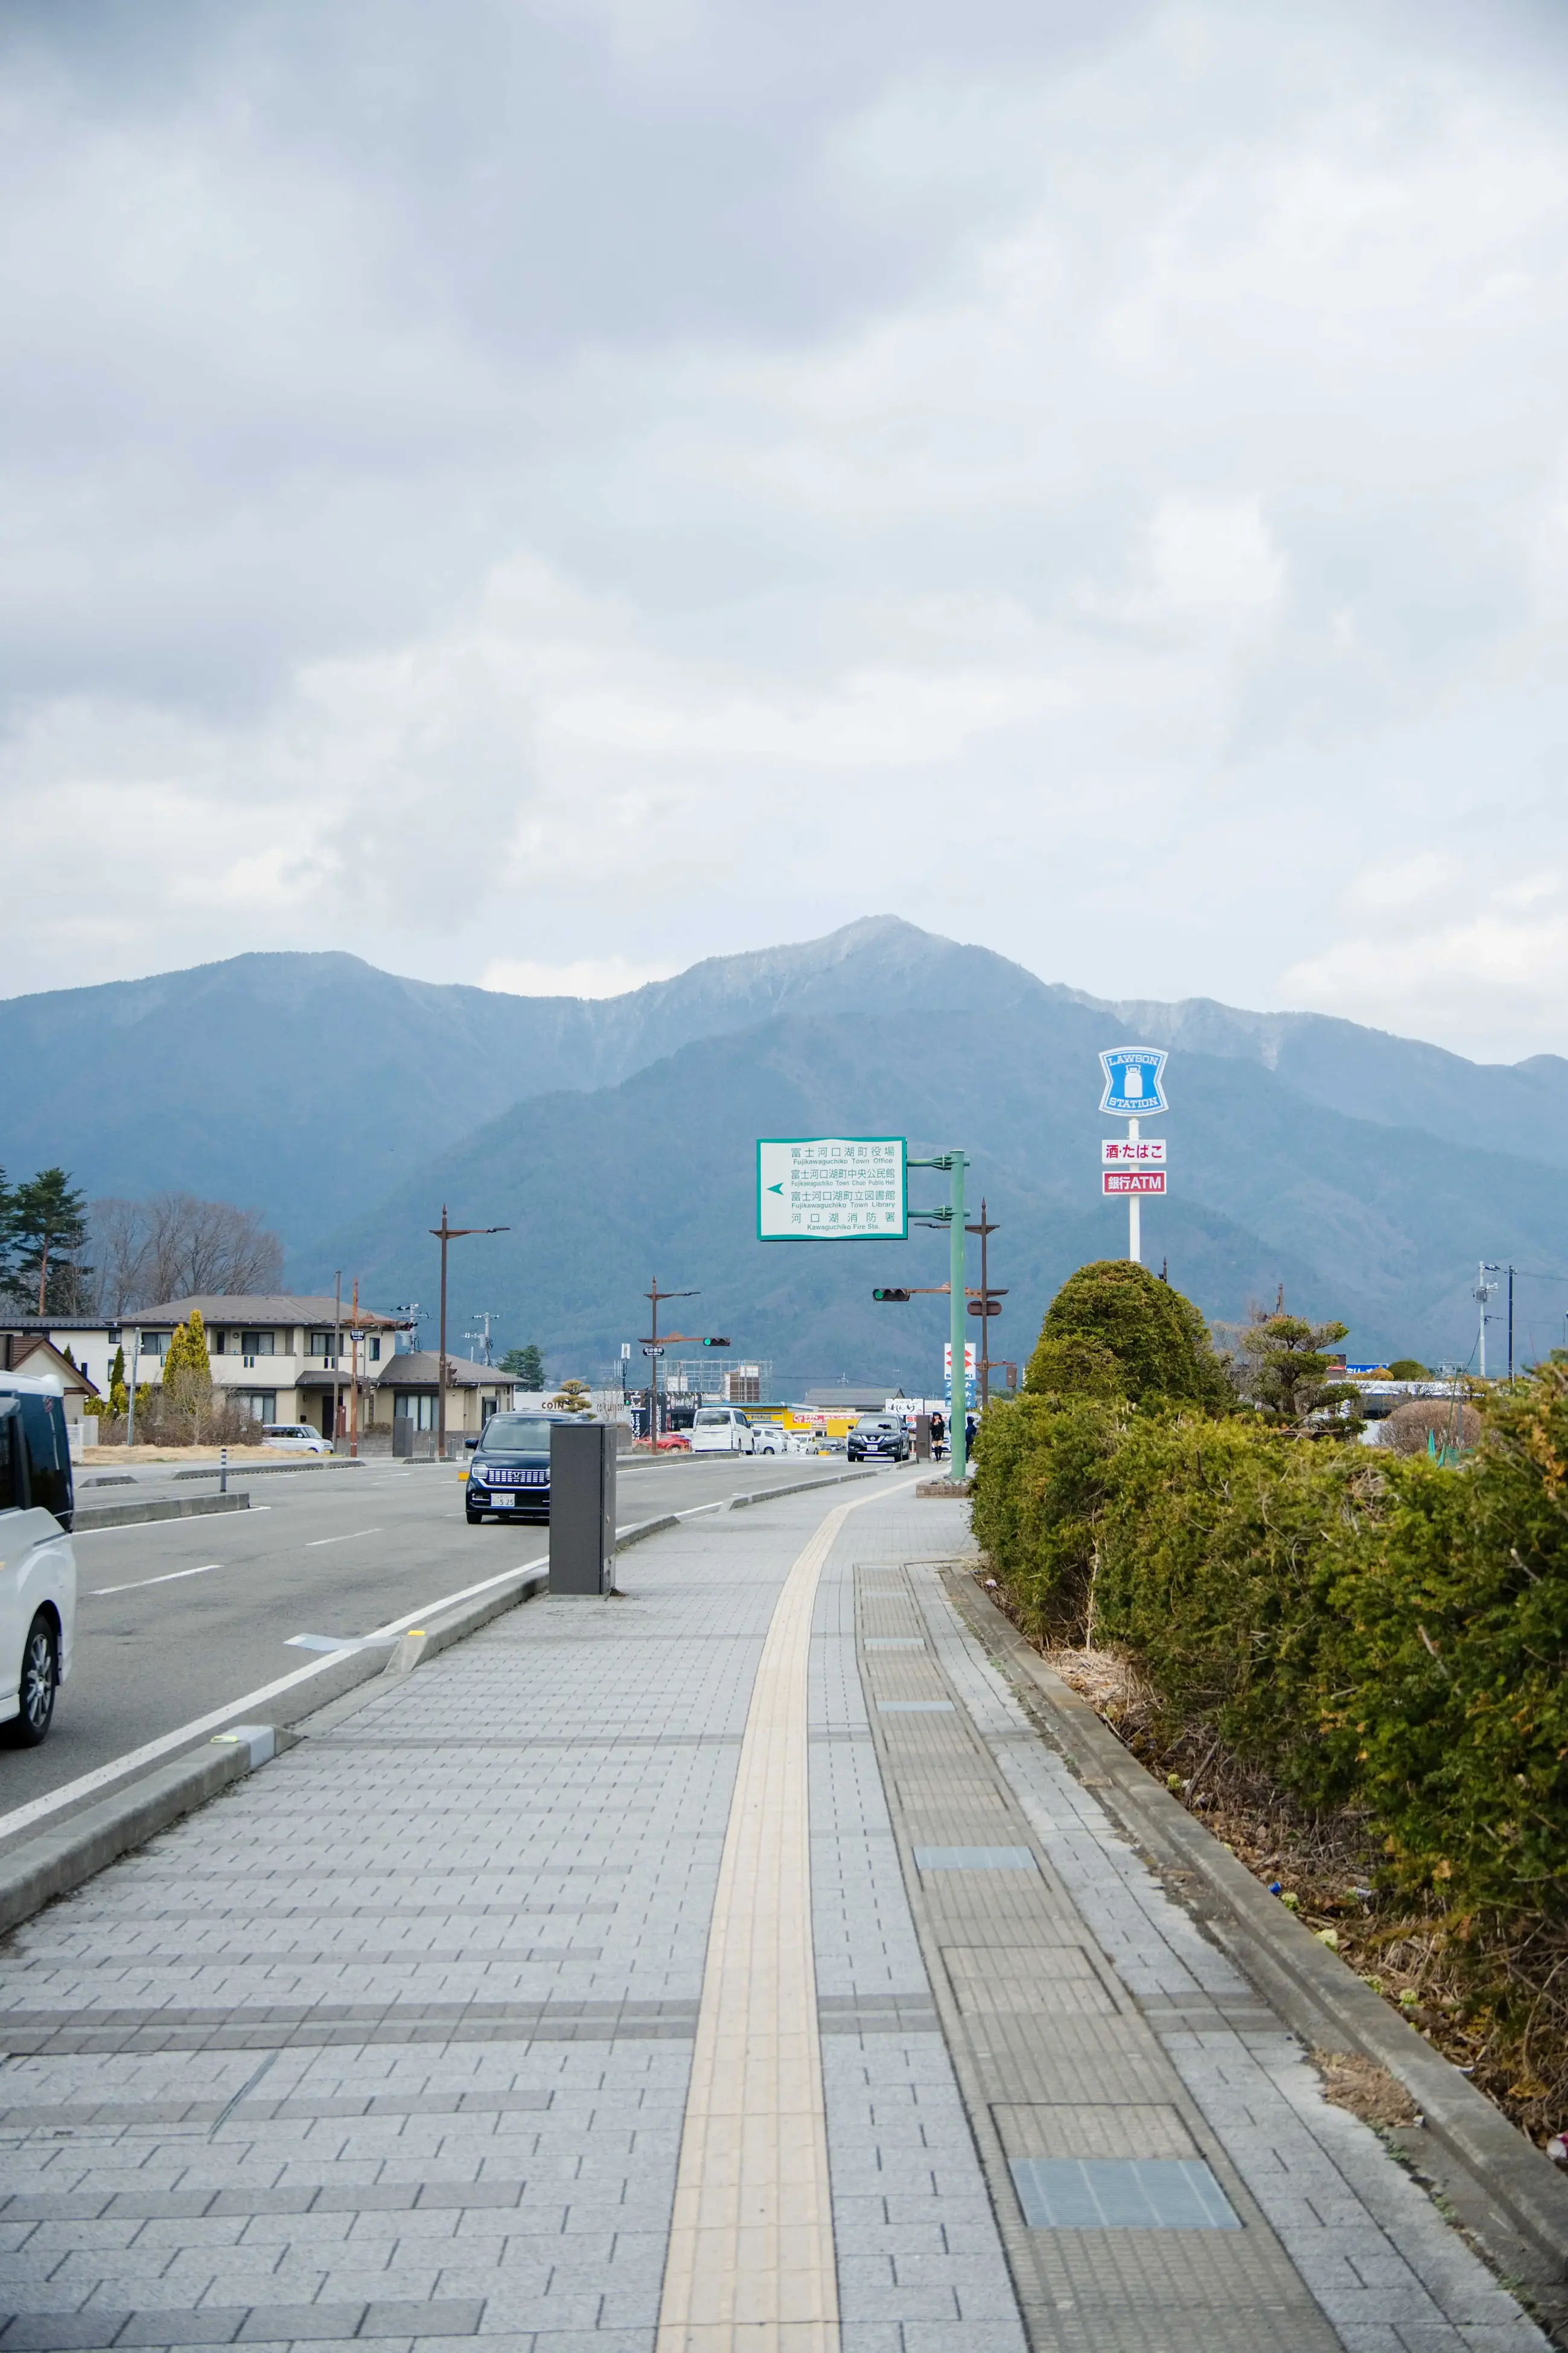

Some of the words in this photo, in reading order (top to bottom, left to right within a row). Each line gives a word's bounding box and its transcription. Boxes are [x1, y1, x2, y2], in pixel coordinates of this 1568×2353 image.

[1108, 1054, 1159, 1067] LAWSON
[1109, 1096, 1158, 1108] STATION
[791, 1146, 895, 1158] 富士河口湖町役場
[791, 1168, 895, 1180] 富士河口湖町中央公民館
[1108, 1176, 1161, 1190] 銀行ATM
[791, 1190, 895, 1201] 富士河口湖町立図書館
[791, 1212, 895, 1223] 河口湖消防署
